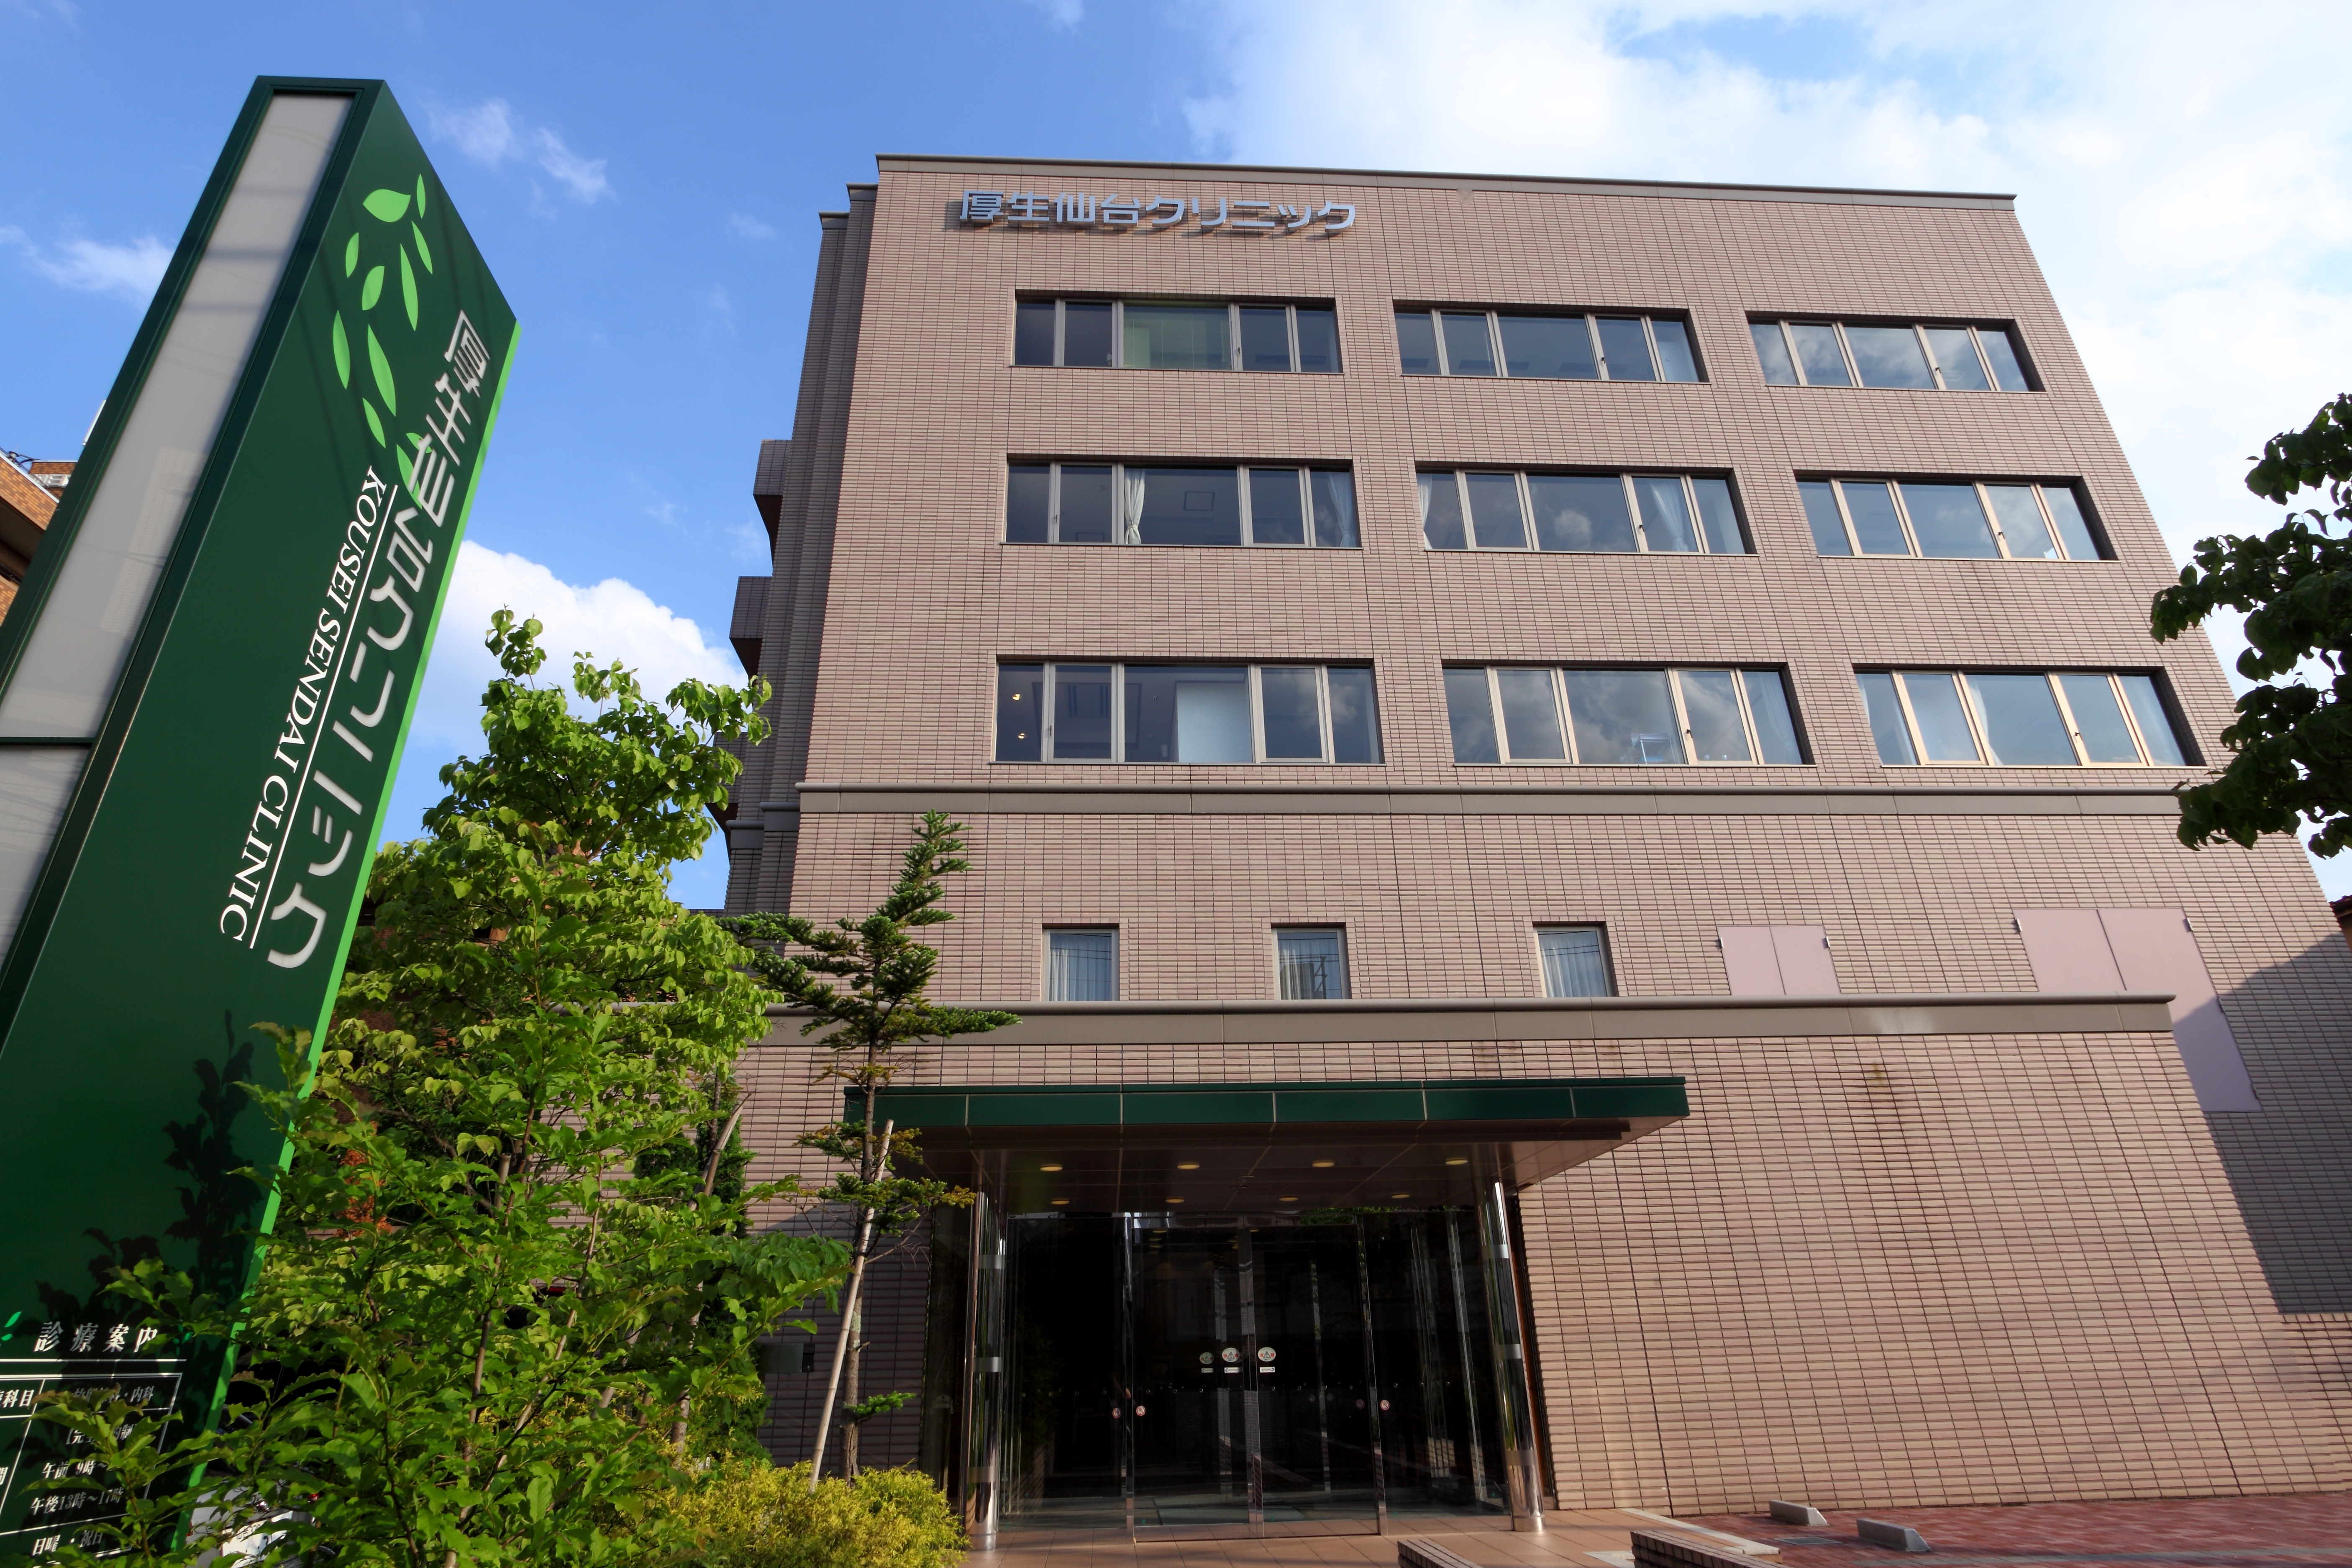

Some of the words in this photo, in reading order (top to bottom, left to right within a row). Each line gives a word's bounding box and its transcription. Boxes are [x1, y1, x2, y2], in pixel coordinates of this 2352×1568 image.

[960, 191, 1356, 230] 厚生仙台クリニック
[327, 466, 387, 614] KOUSEI
[267, 309, 490, 968] 厚生仙台クリニック
[274, 608, 341, 773] SENDAI
[220, 775, 288, 941] CLINIC
[33, 1321, 158, 1353] 診療案内
